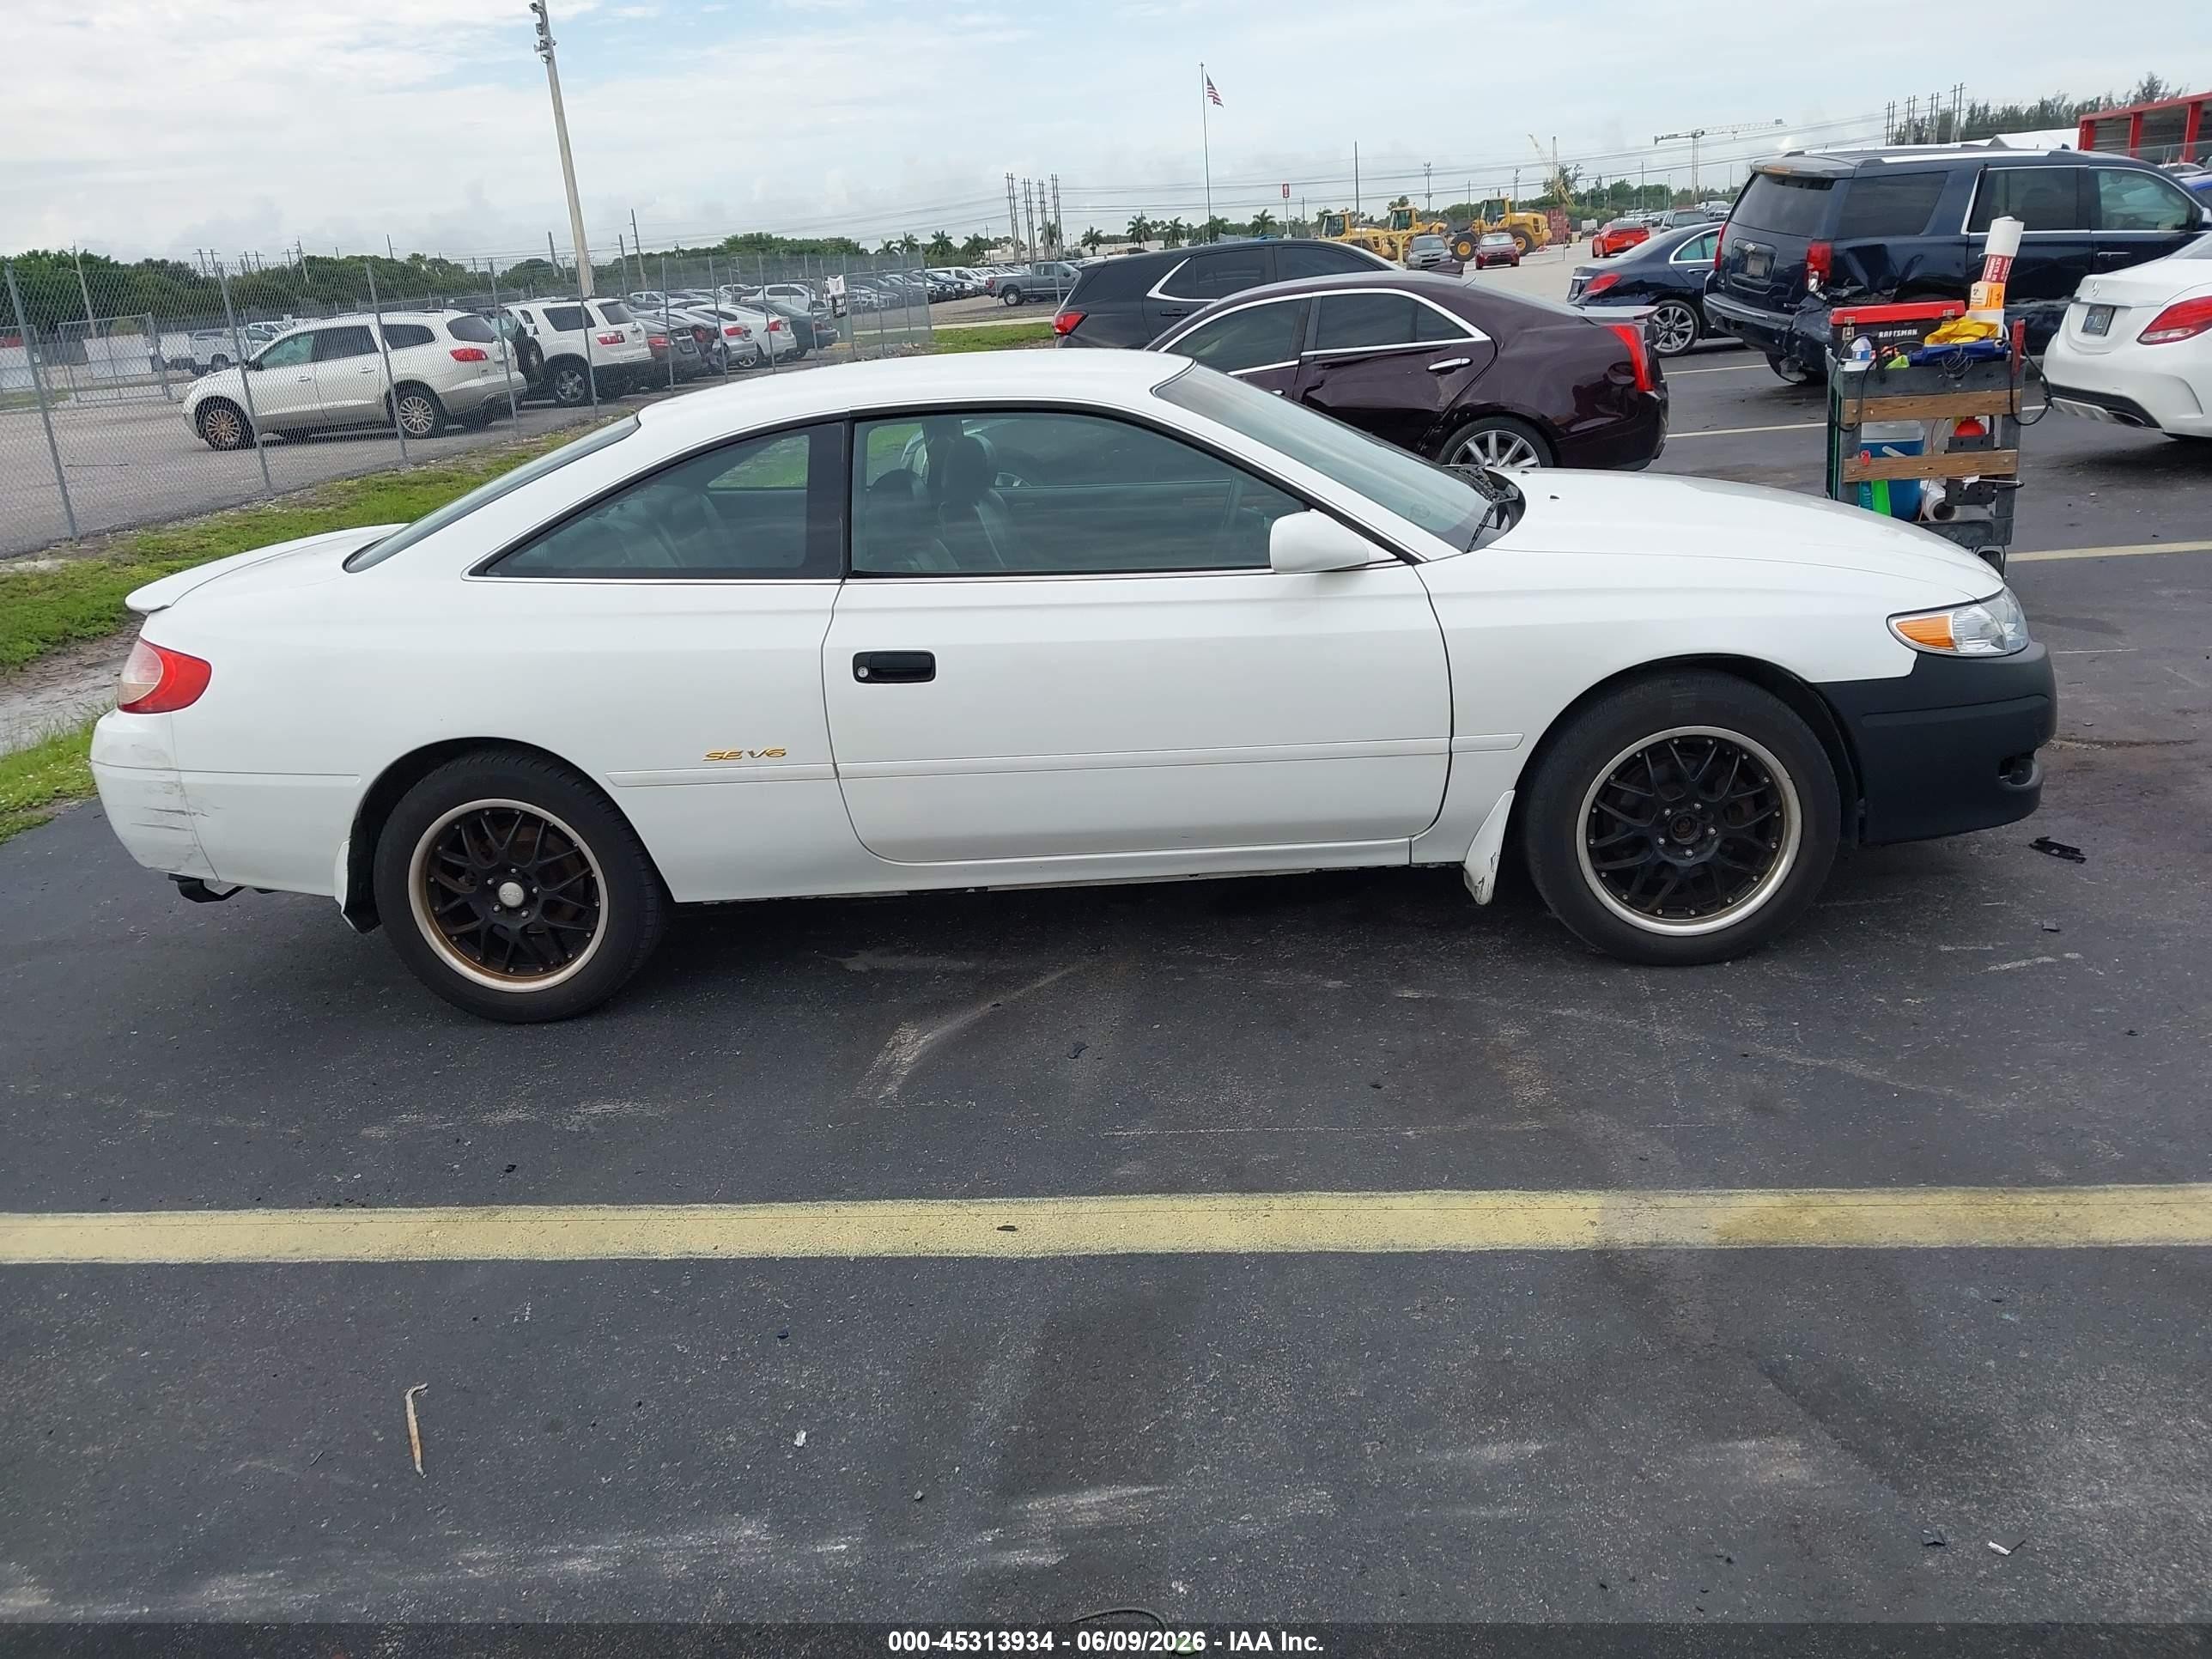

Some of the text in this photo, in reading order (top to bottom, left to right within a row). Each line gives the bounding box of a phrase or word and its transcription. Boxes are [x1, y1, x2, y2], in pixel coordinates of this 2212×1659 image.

[1877, 328, 1919, 338] RAFTSMAN
[702, 747, 787, 762] SE V6
